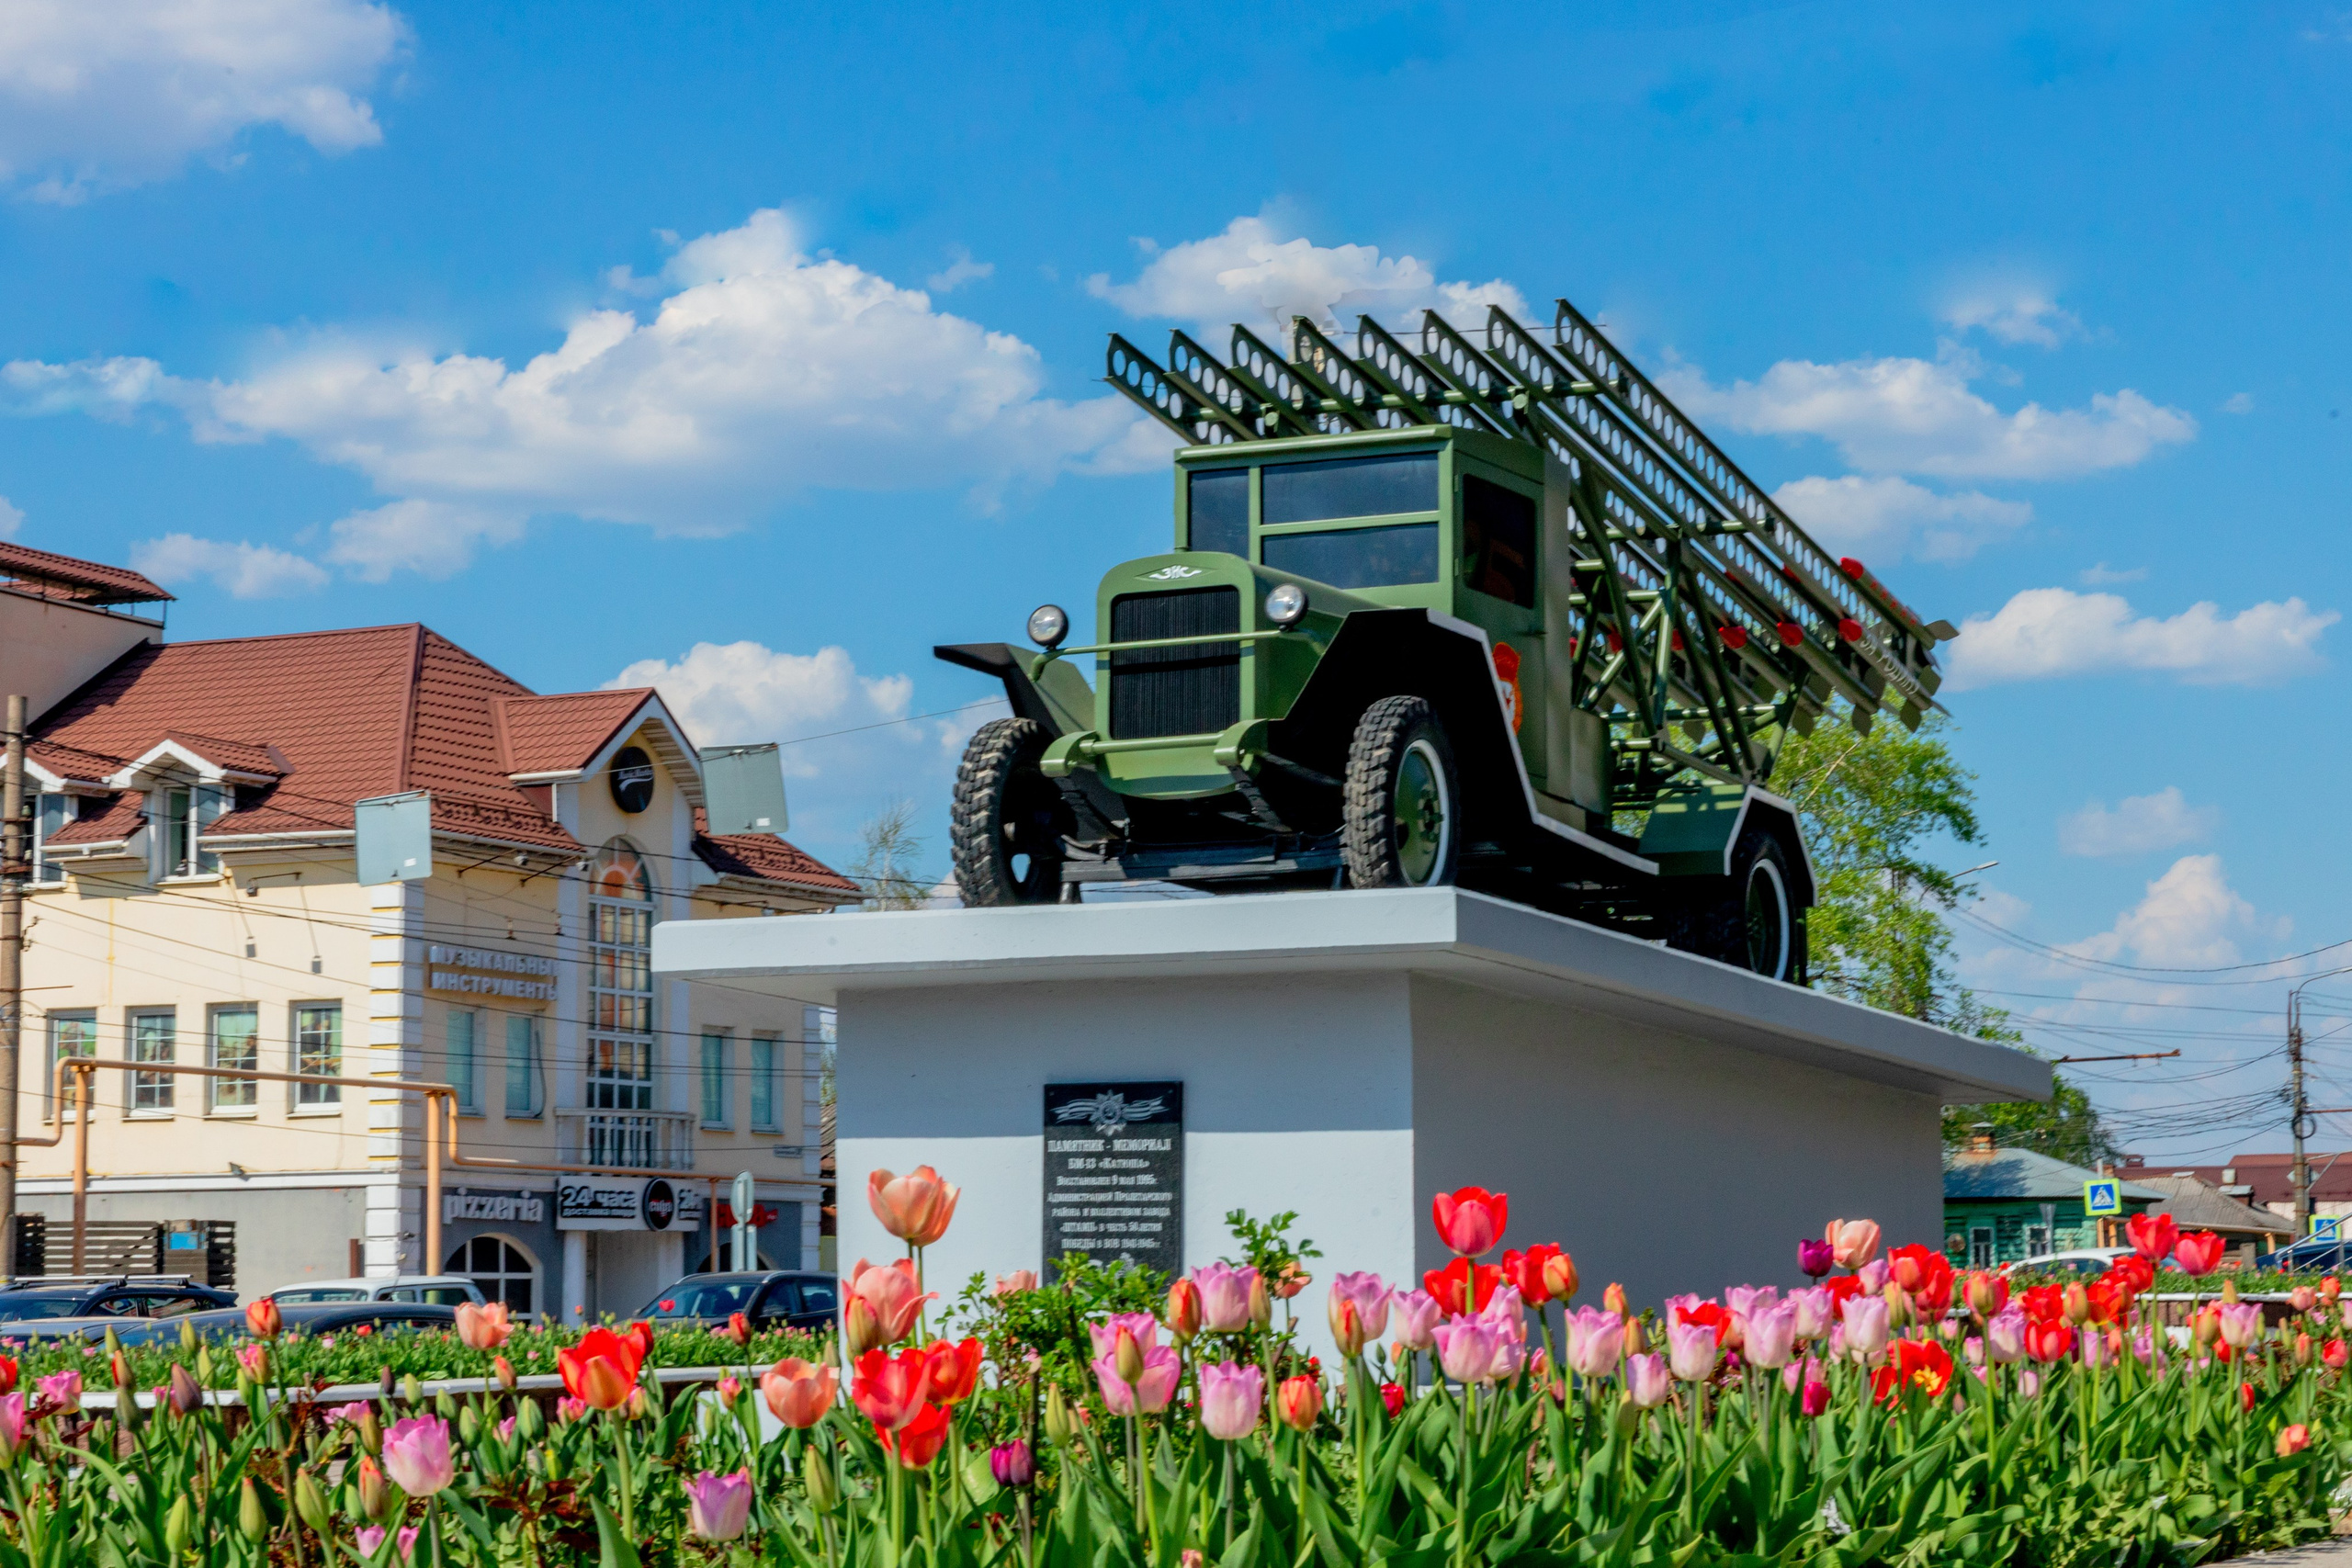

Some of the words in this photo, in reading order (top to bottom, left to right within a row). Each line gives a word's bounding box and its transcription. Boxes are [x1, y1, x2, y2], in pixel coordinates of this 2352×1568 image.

[1047, 1139, 1105, 1152] ПАМЯТНИК
[1113, 1138, 1171, 1152] МЕМОРИАЛ
[1111, 1174, 1118, 1185] 9
[443, 1187, 545, 1224] pizzeria
[562, 1187, 593, 1206] 24
[595, 1191, 637, 1207] часа
